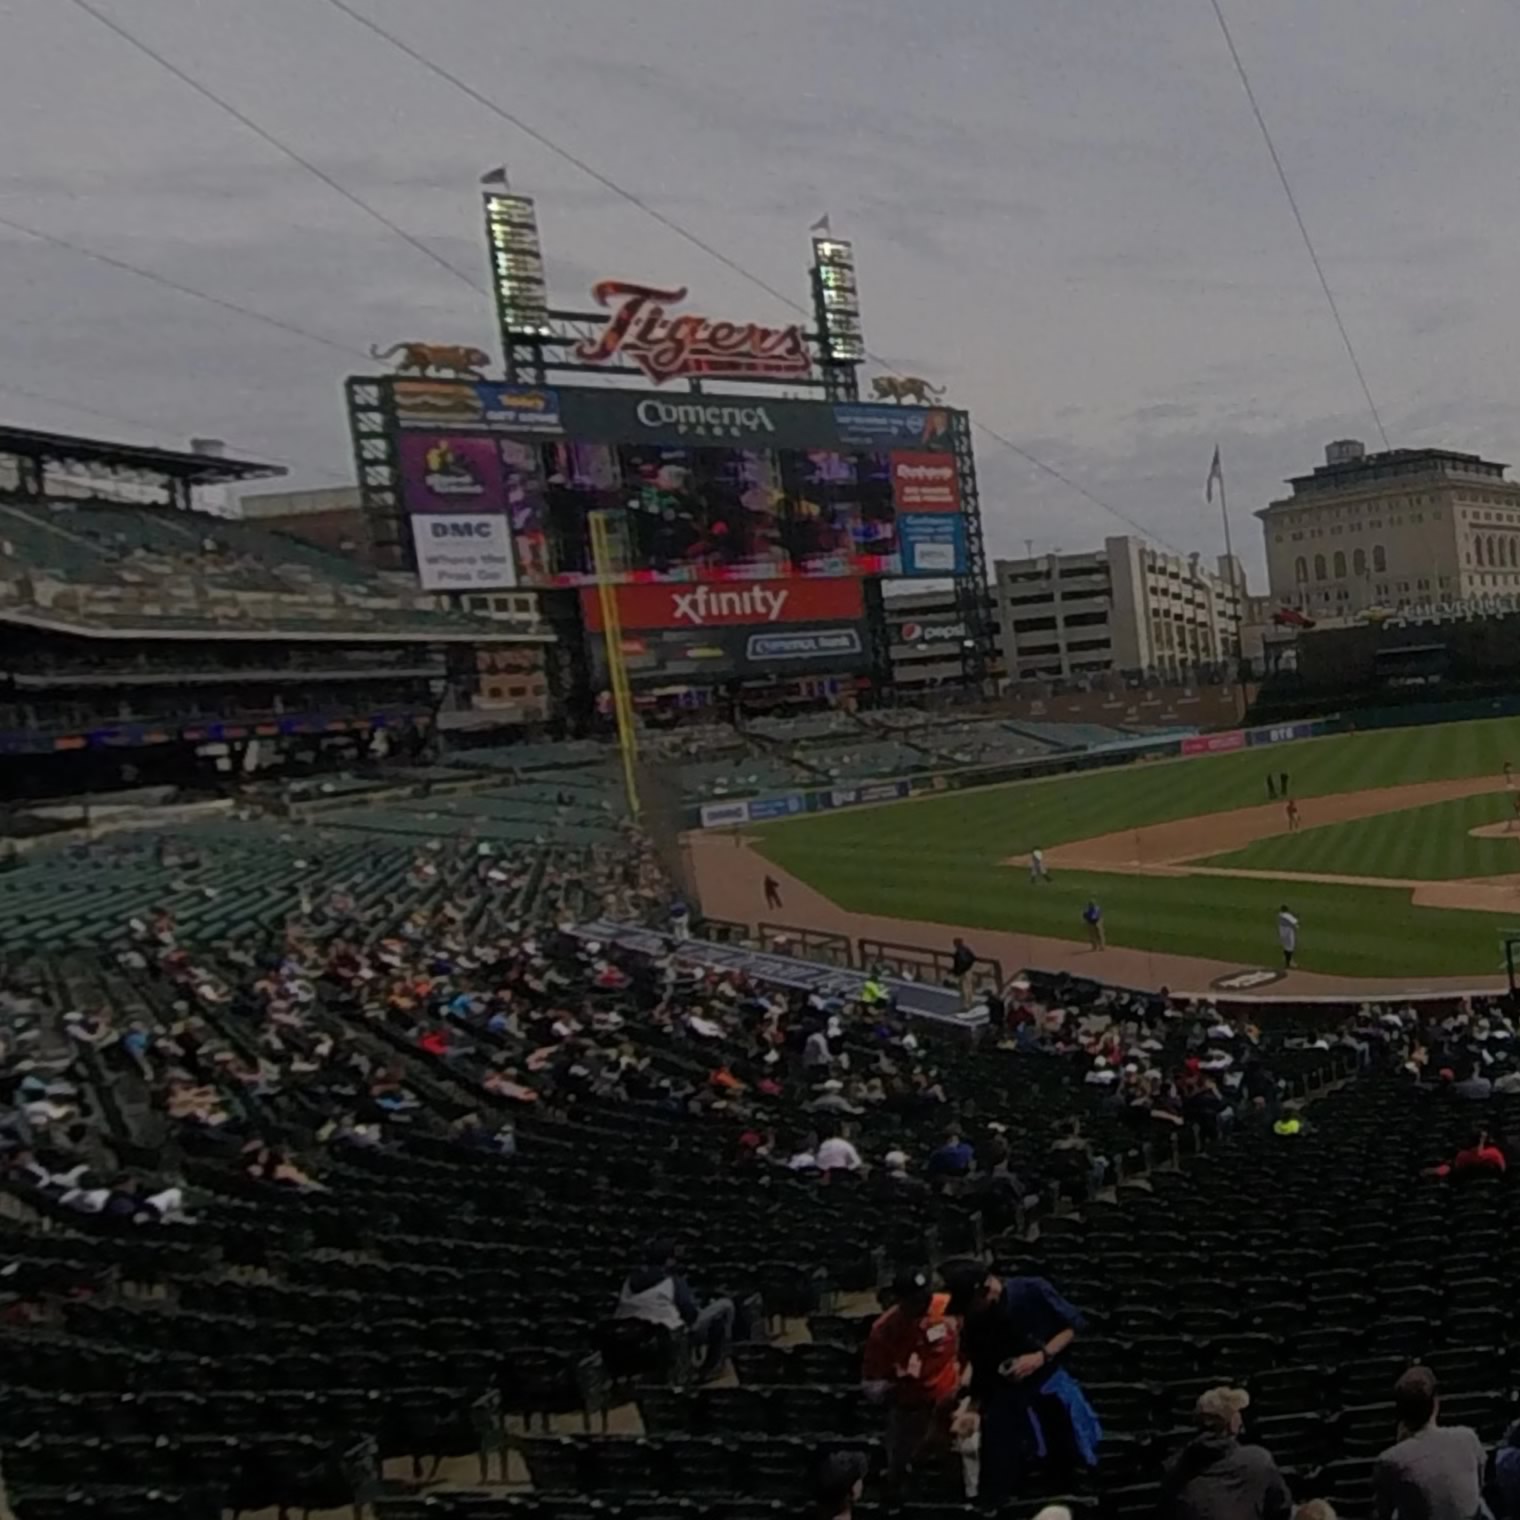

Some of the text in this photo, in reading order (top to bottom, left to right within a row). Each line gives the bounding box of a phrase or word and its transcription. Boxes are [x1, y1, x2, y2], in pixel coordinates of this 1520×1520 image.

[575, 280, 812, 385] Tigers
[430, 522, 492, 538] DMC
[671, 584, 789, 624] xfinity
[924, 623, 967, 640] pepsi
